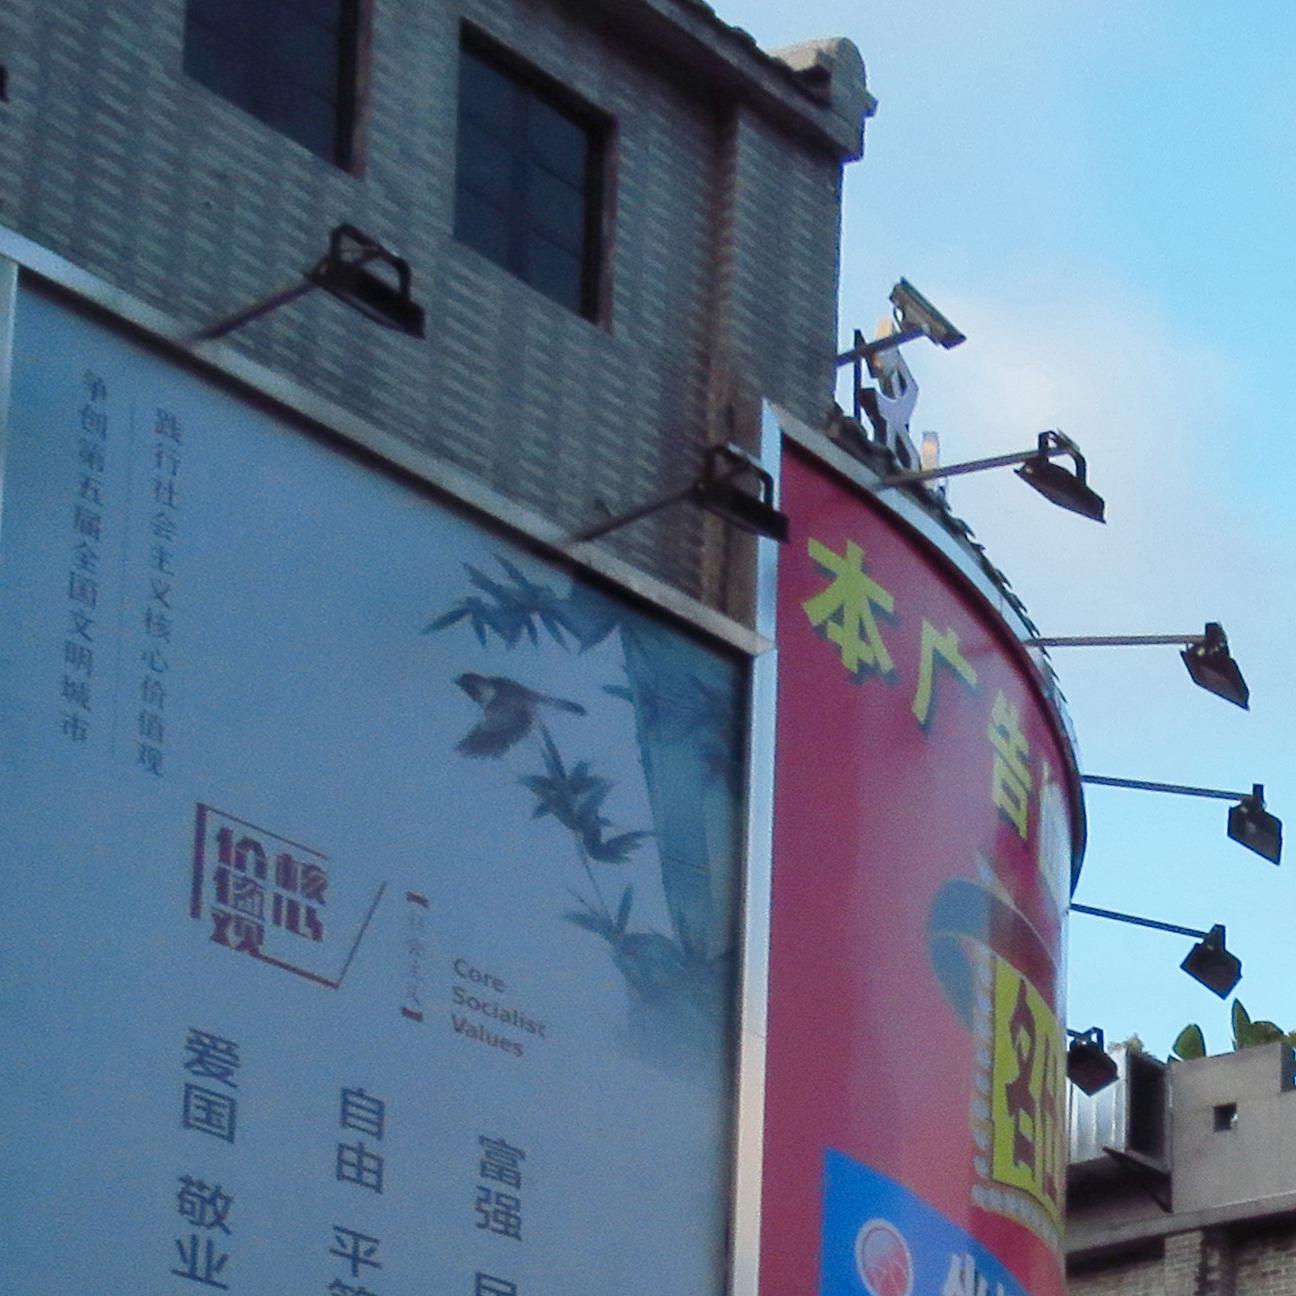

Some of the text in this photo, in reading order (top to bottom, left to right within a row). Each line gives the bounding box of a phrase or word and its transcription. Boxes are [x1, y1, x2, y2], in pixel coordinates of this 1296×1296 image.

[800, 536, 1062, 900] 本广告
[451, 984, 548, 1039] Socialist
[453, 956, 506, 993] Core
[182, 1026, 241, 1143] 爱国
[450, 1013, 525, 1058] Values
[335, 1086, 386, 1195] 自由
[475, 1135, 526, 1241] 富强
[171, 1174, 234, 1290] 敬业
